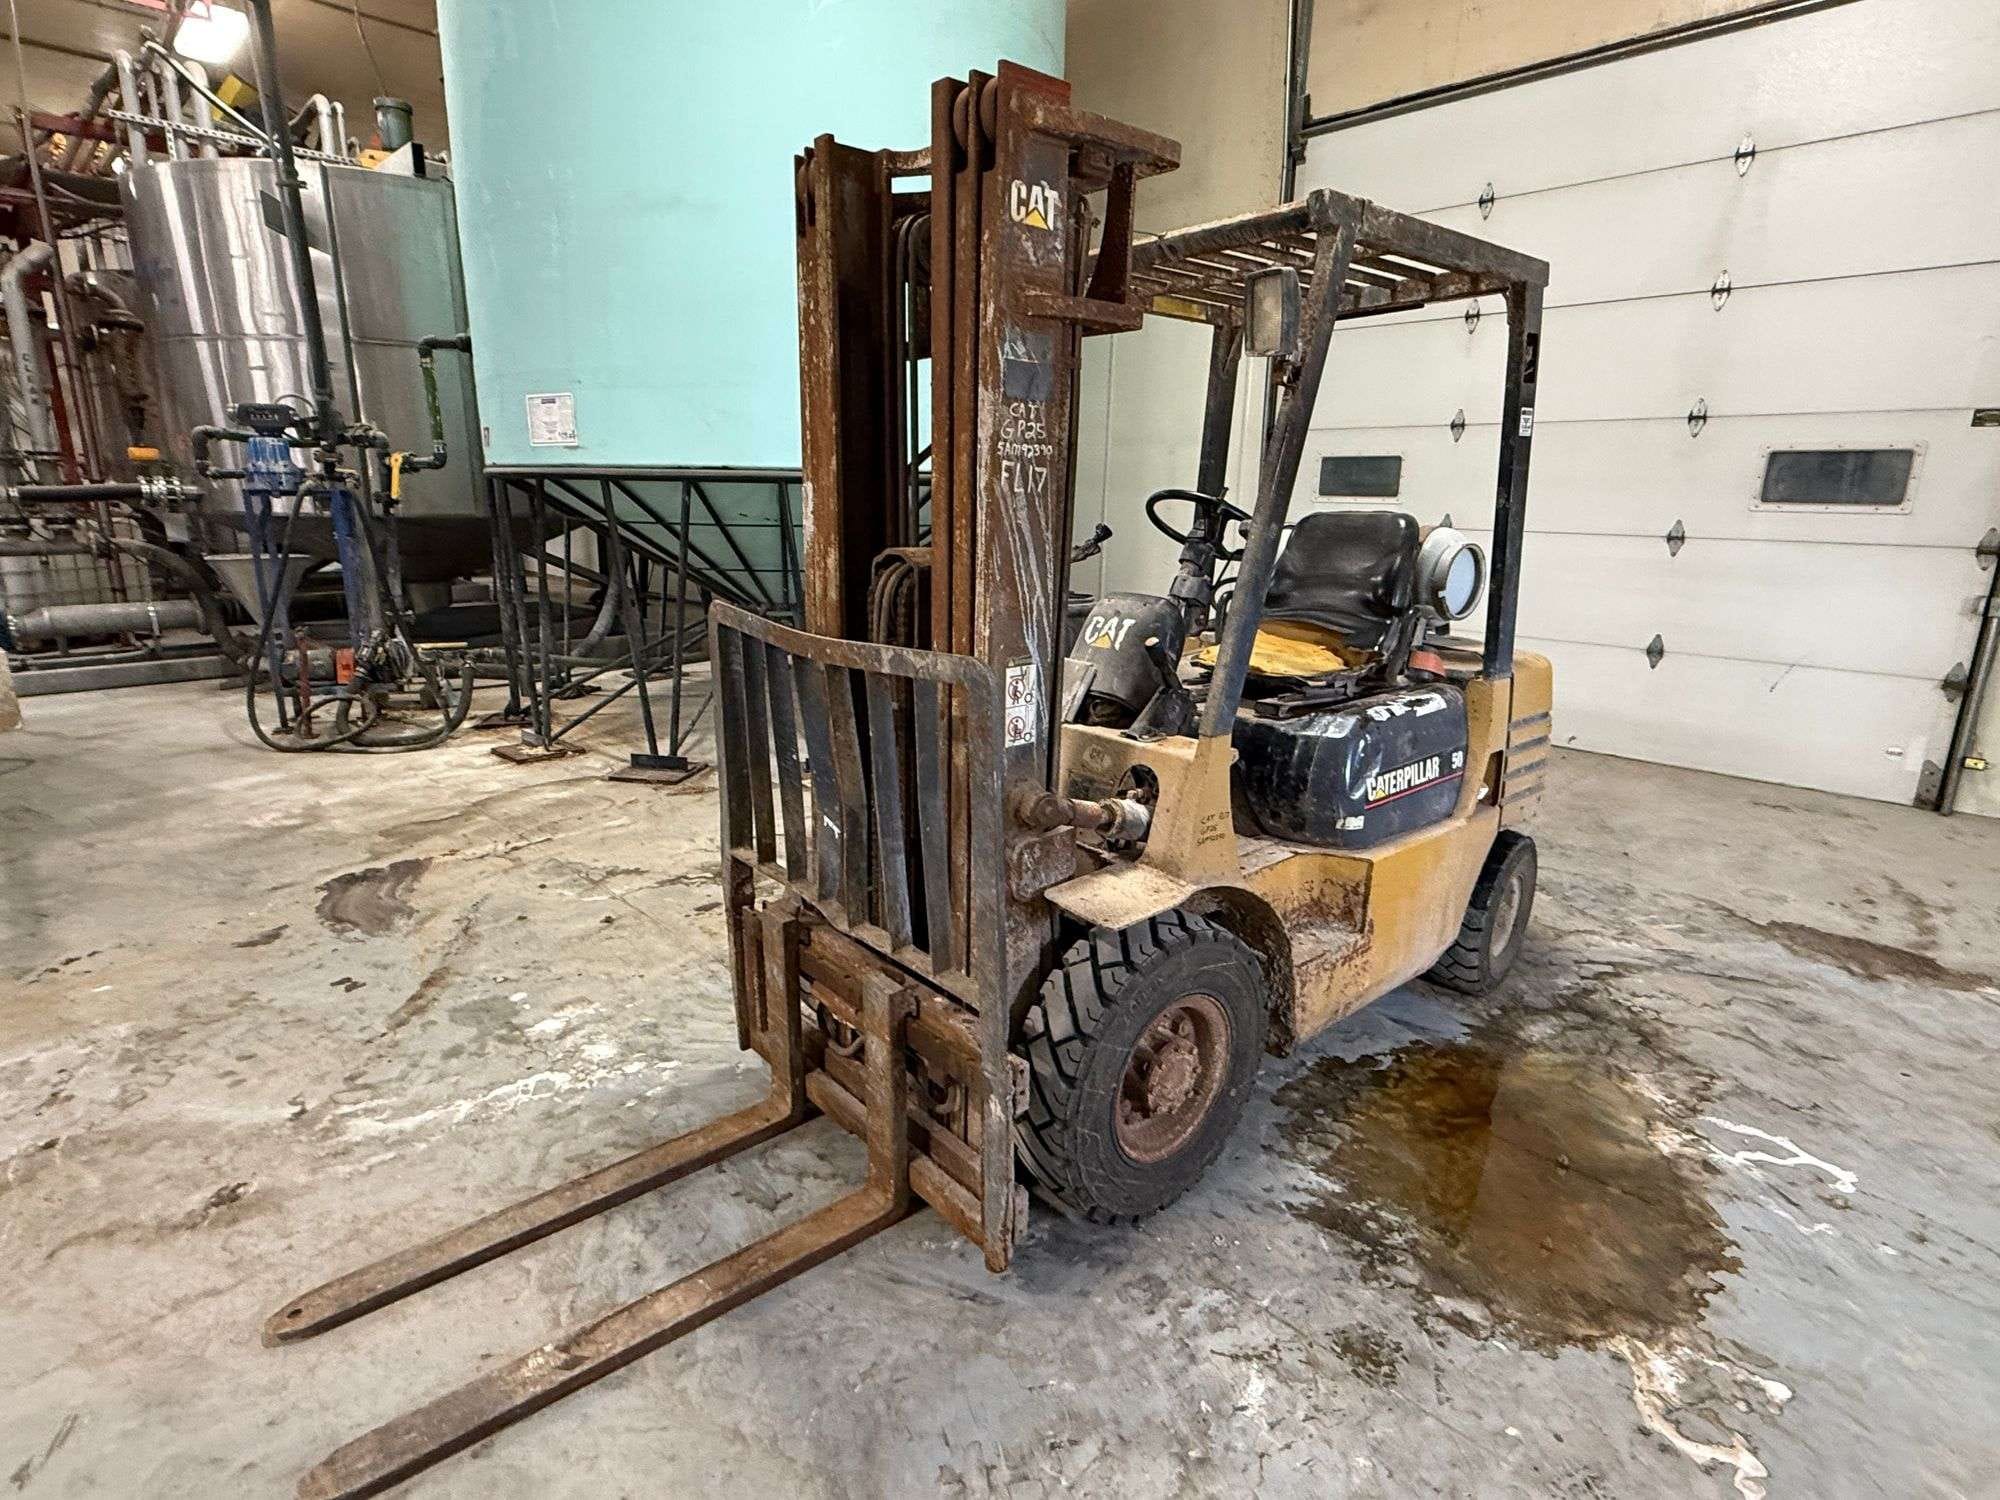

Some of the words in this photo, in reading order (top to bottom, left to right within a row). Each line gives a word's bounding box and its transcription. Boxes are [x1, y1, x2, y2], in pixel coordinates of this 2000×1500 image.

[1010, 180, 1061, 231] CAT
[1009, 402, 1038, 419] CAT
[1000, 419, 1047, 440] GP25
[1001, 460, 1047, 493] FL17
[1085, 616, 1136, 650] CAT
[1366, 756, 1440, 801] CATERPILLAR
[1451, 751, 1464, 769] 50
